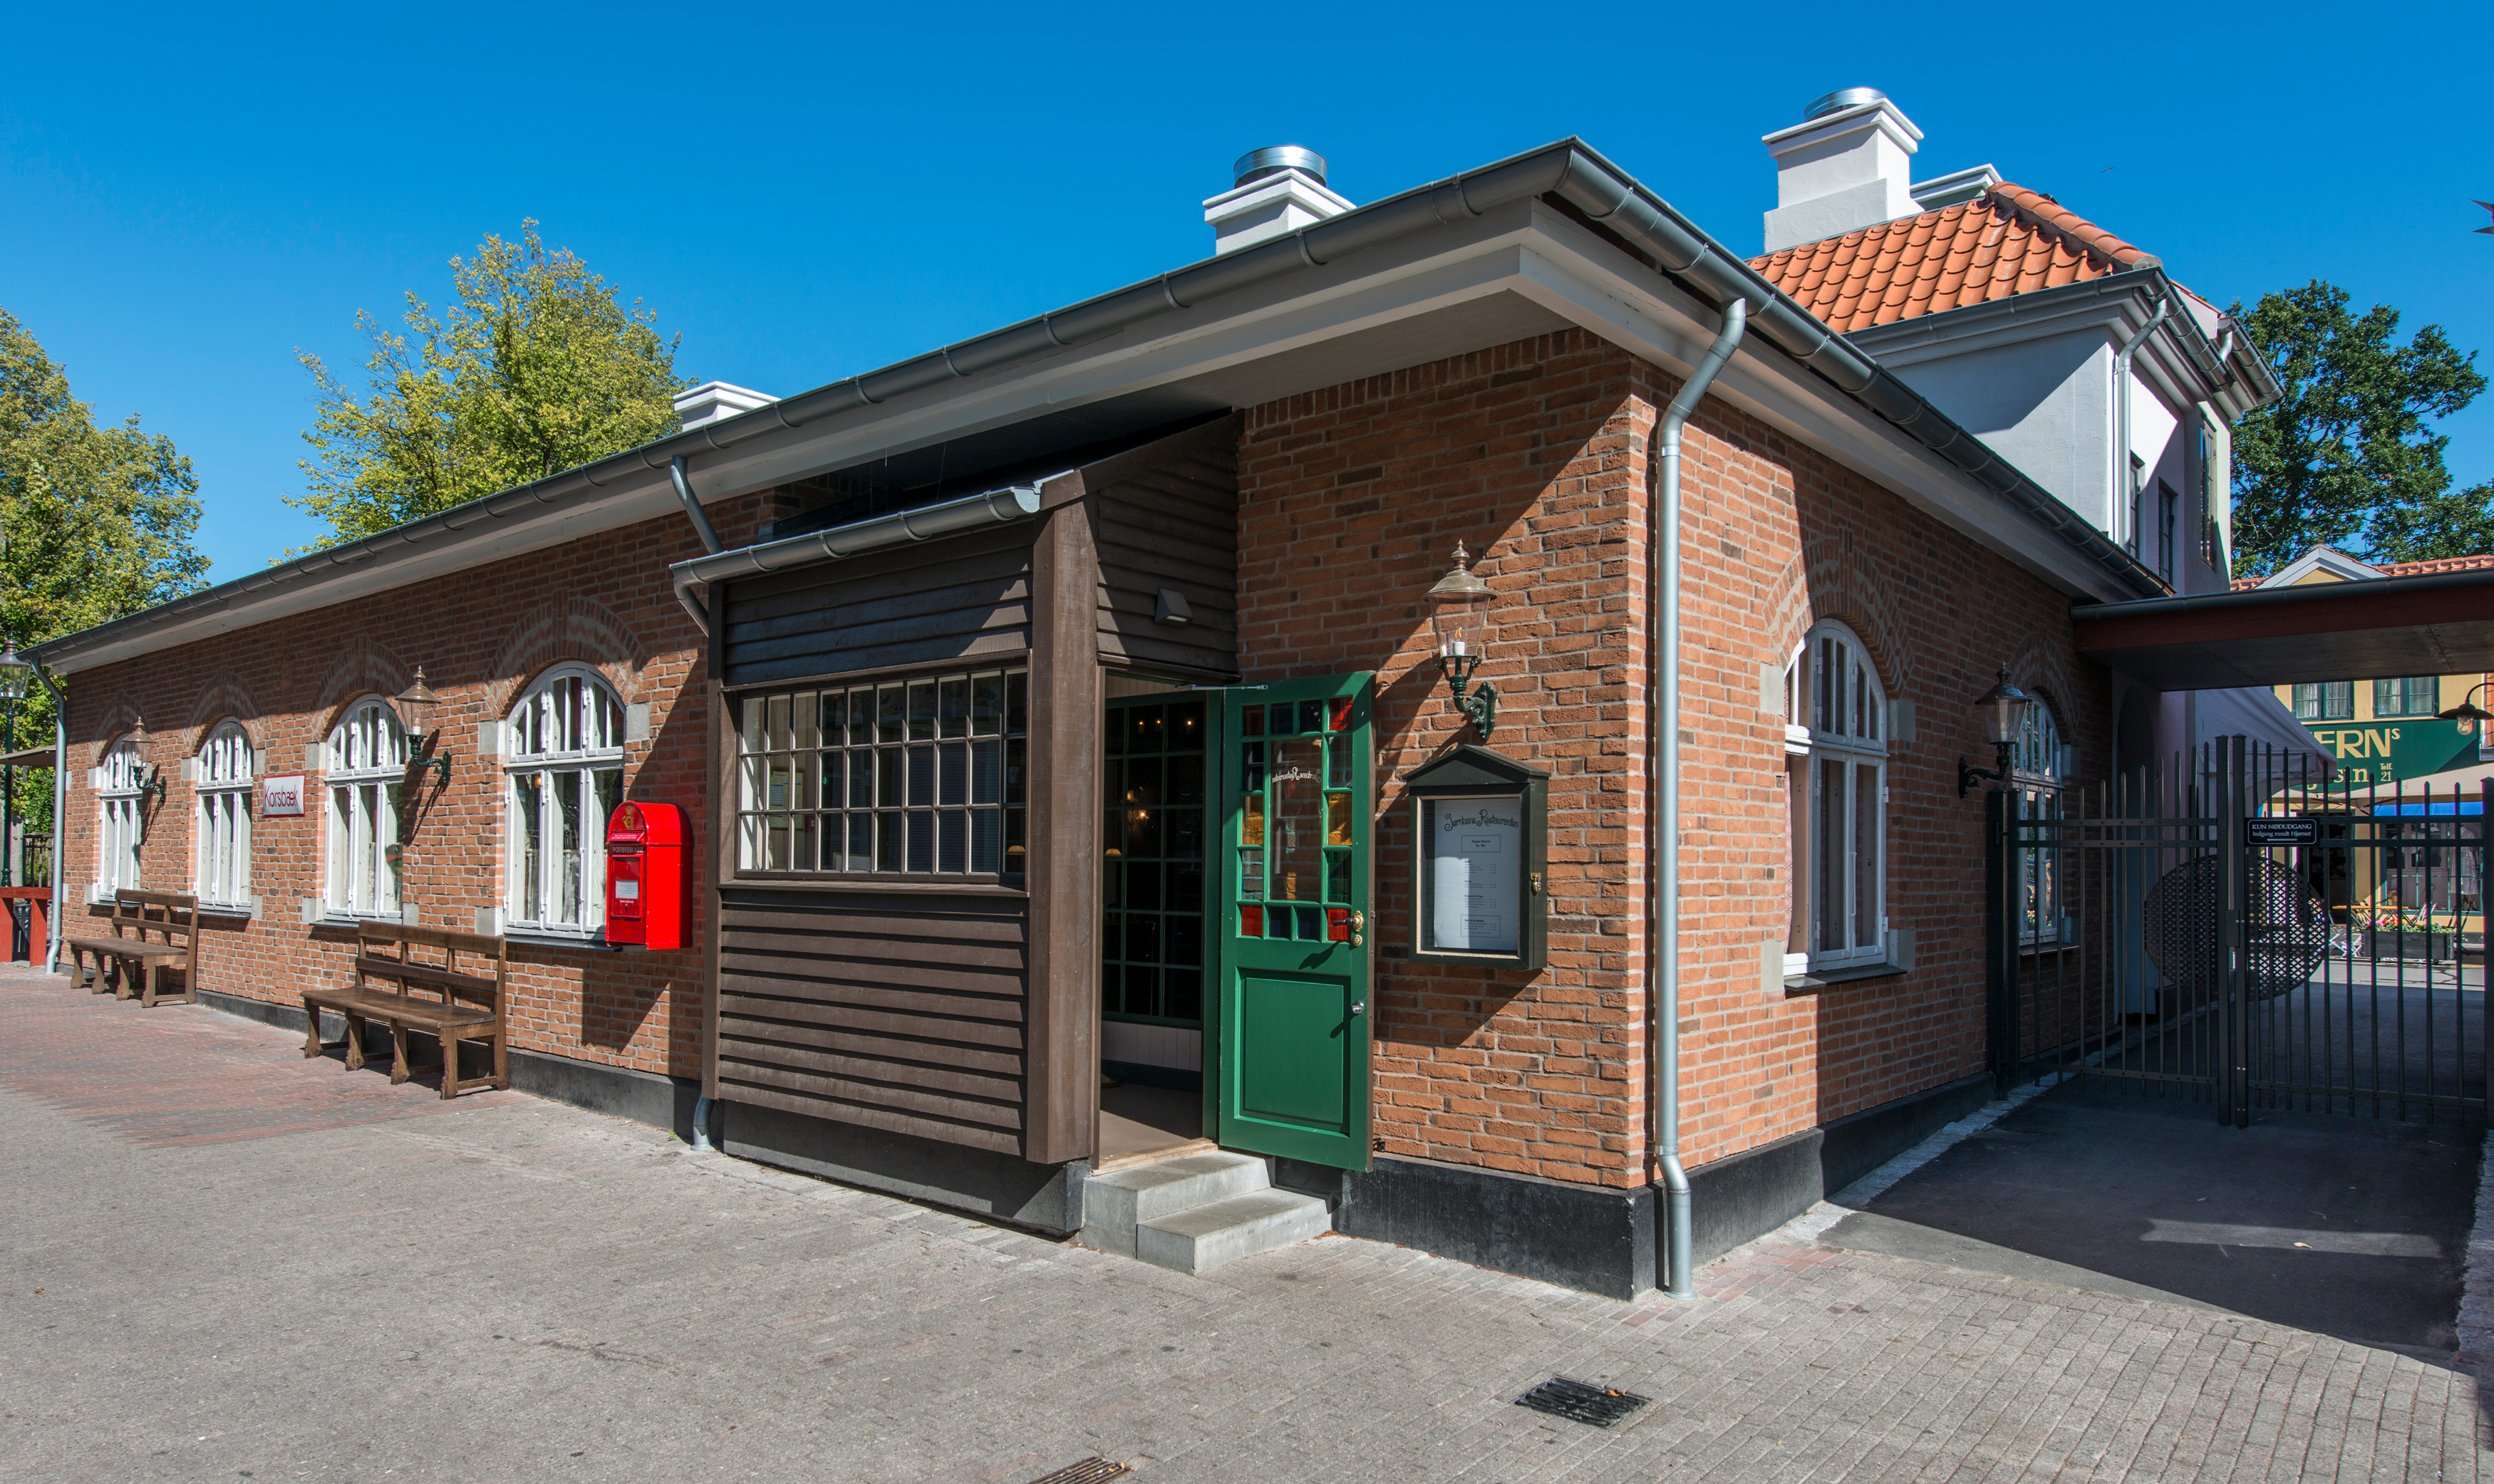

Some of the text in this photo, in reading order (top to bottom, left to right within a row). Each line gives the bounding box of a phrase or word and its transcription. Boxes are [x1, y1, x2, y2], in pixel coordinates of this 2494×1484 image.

[2381, 772, 2392, 782] 21
[264, 784, 299, 807] Korsbæk
[1444, 809, 1518, 831] Jernbane Restauranten
